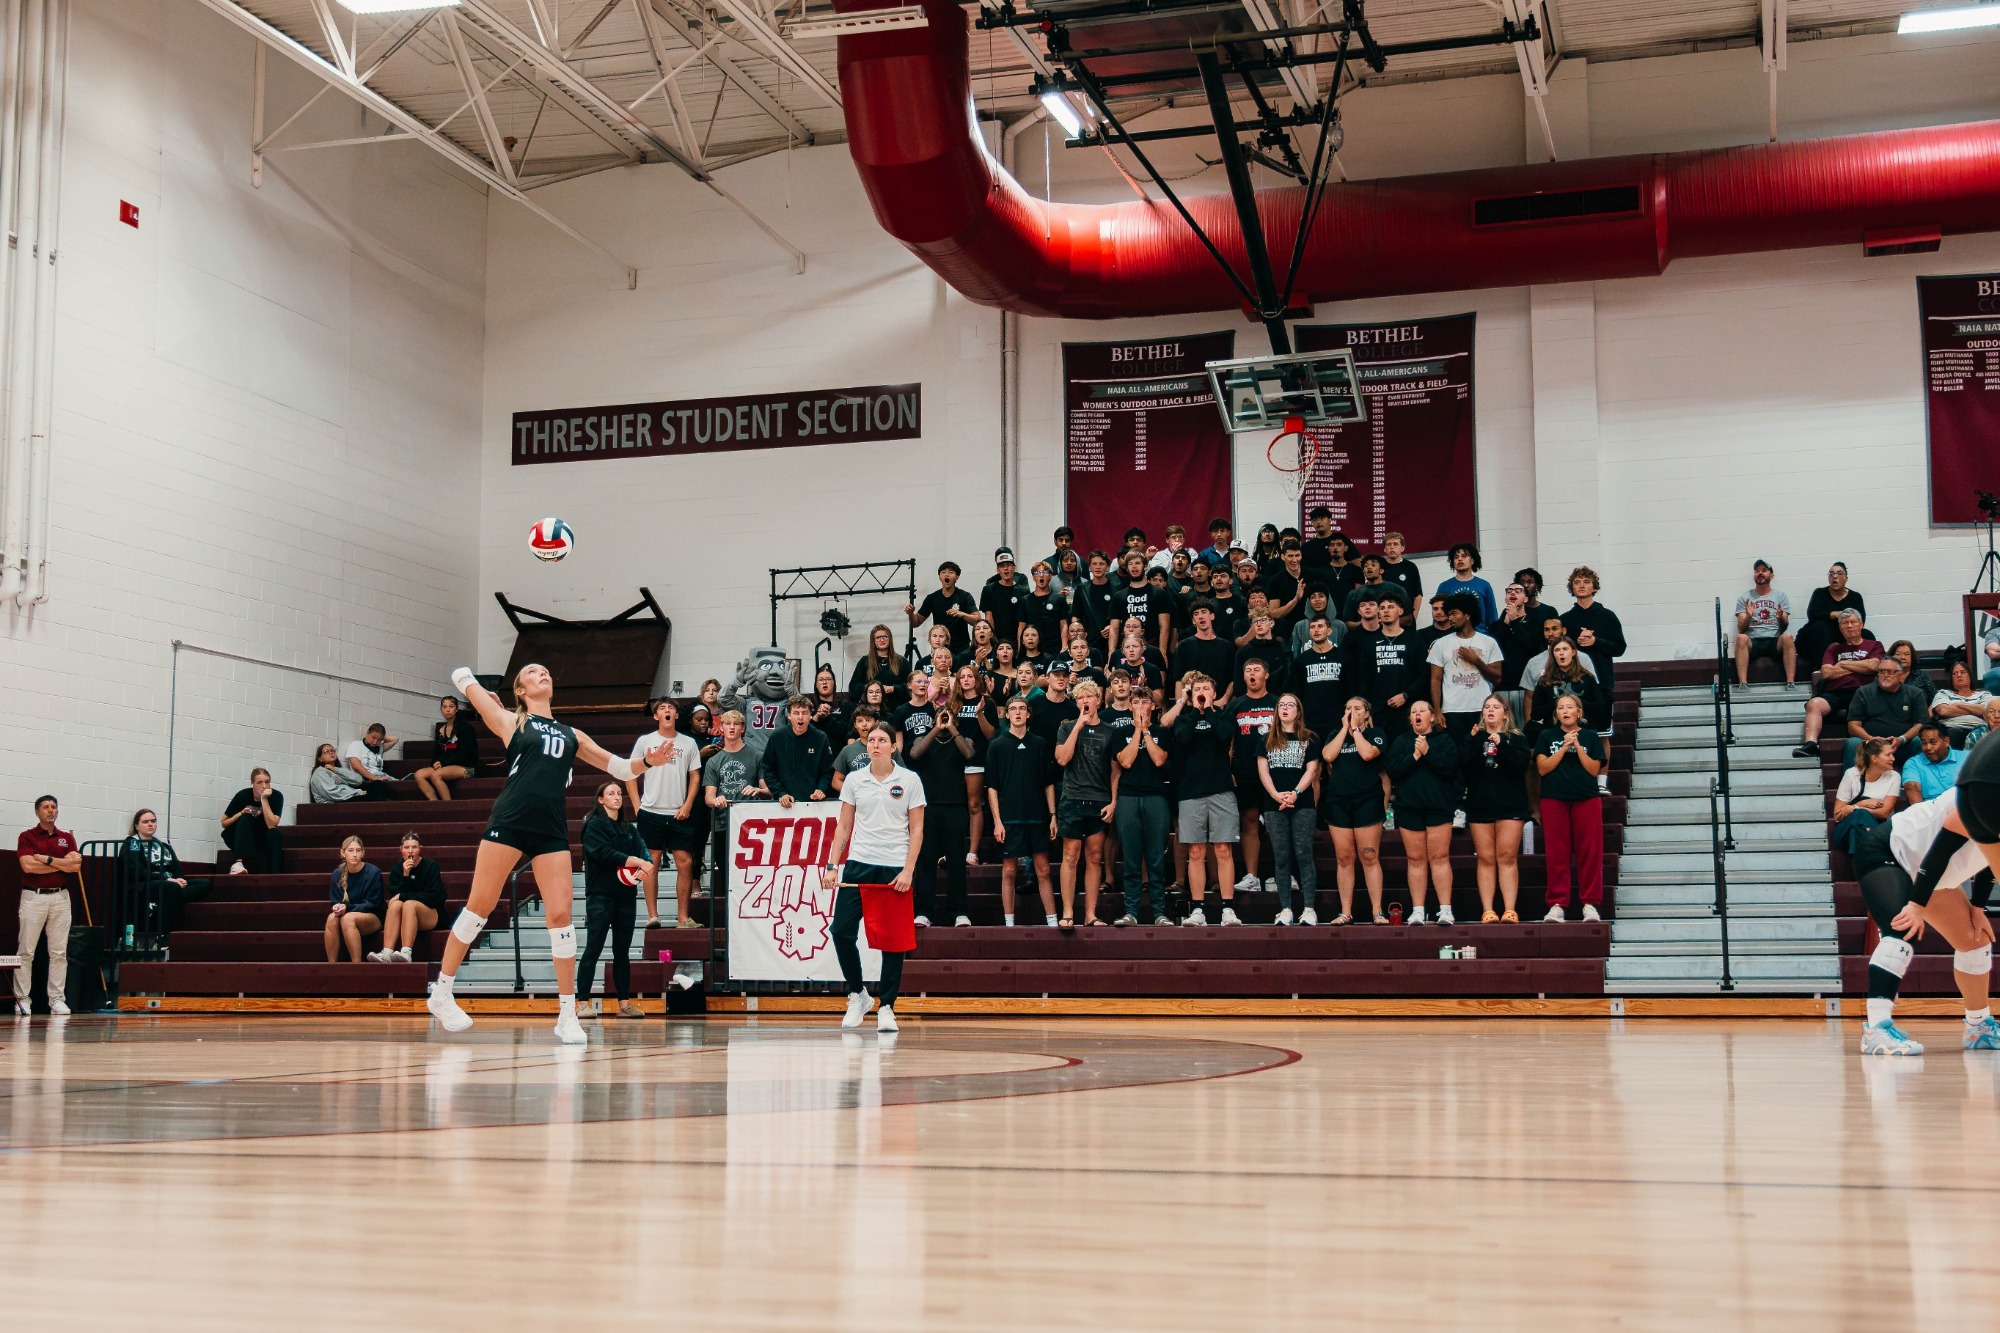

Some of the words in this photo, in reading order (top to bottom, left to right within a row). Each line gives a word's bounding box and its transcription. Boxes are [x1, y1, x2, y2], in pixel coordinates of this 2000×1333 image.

[1346, 326, 1424, 345] BETHEL
[1960, 324, 1982, 332] NAIA
[1111, 343, 1184, 362] BETHEL
[1111, 360, 1184, 376] COLLEGE
[1364, 366, 1428, 378] ALL-AMERICANS
[1108, 386, 1126, 394] NAIA
[1128, 382, 1188, 394] ALL-AMERICANS
[1323, 386, 1348, 394] MEN'S
[1350, 384, 1388, 393] OTDOOR
[1391, 382, 1416, 390] TRACK
[1418, 380, 1425, 388] &
[1427, 378, 1448, 388] FIELD
[1082, 400, 1118, 409] WOMEN'S
[1120, 399, 1157, 408] OUTDOOR
[1160, 396, 1184, 406] TRACK
[1193, 394, 1214, 402] FIELD
[516, 412, 652, 456] THRESHER
[662, 402, 788, 446] STUDENT
[797, 393, 917, 436] SECTION
[1127, 594, 1148, 604] God
[1754, 600, 1777, 610] ETHEL
[1127, 604, 1148, 614] first
[1306, 662, 1342, 676] THRESHERS
[752, 704, 780, 730] 37
[1242, 724, 1250, 735] N
[542, 734, 564, 758] 10
[735, 816, 854, 869] STON
[739, 864, 836, 918] ZON
